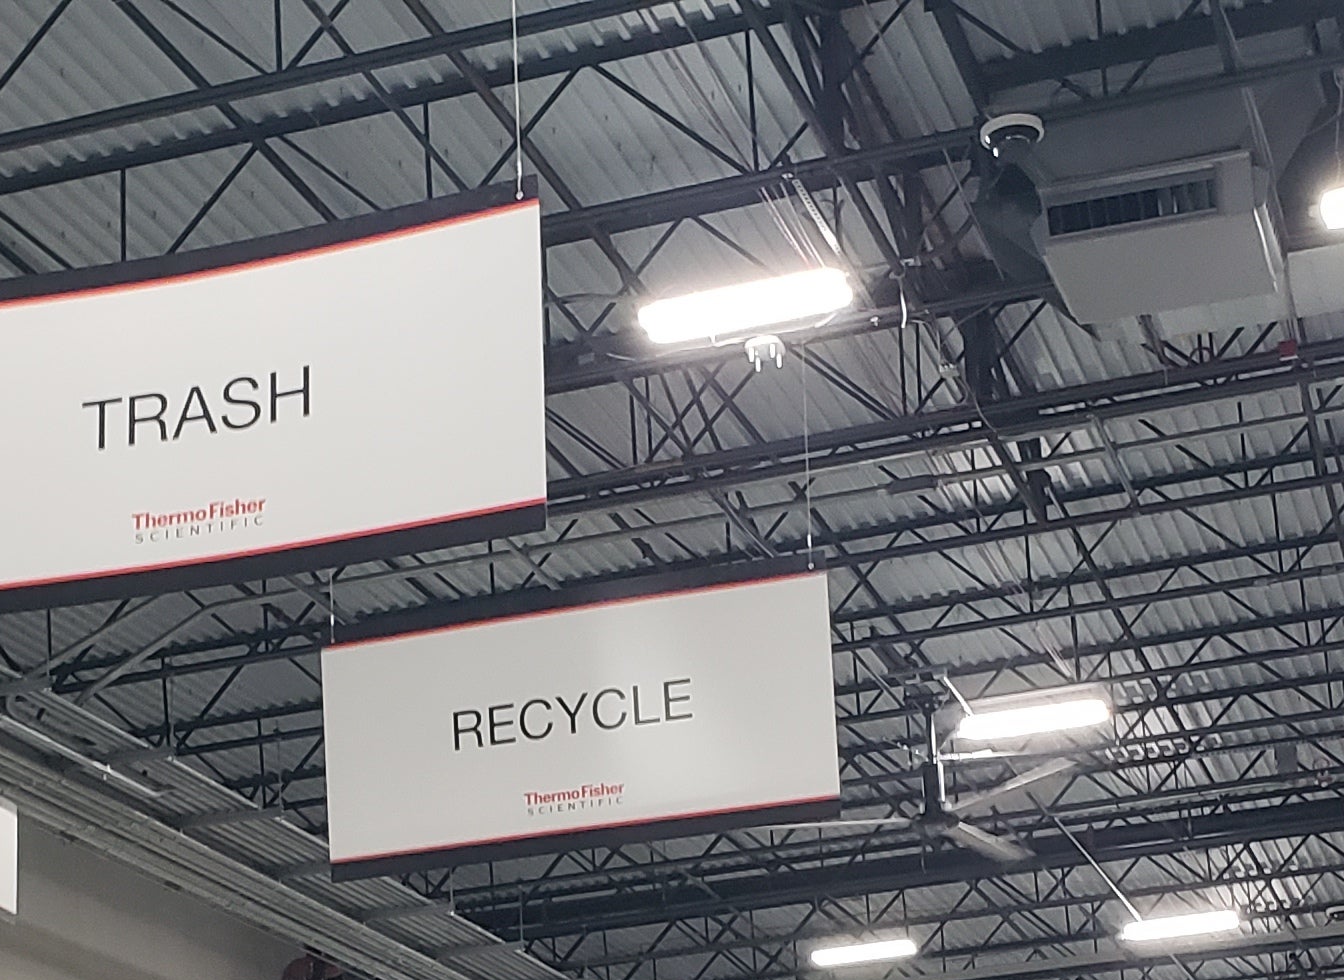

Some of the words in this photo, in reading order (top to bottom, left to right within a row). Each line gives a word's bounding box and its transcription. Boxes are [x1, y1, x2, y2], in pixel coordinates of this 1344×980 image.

[82, 365, 311, 451] TRASH
[135, 514, 265, 545] SCIENTIFIC
[453, 677, 694, 751] RECYCLE
[527, 795, 625, 817] SCIENTIFIC
